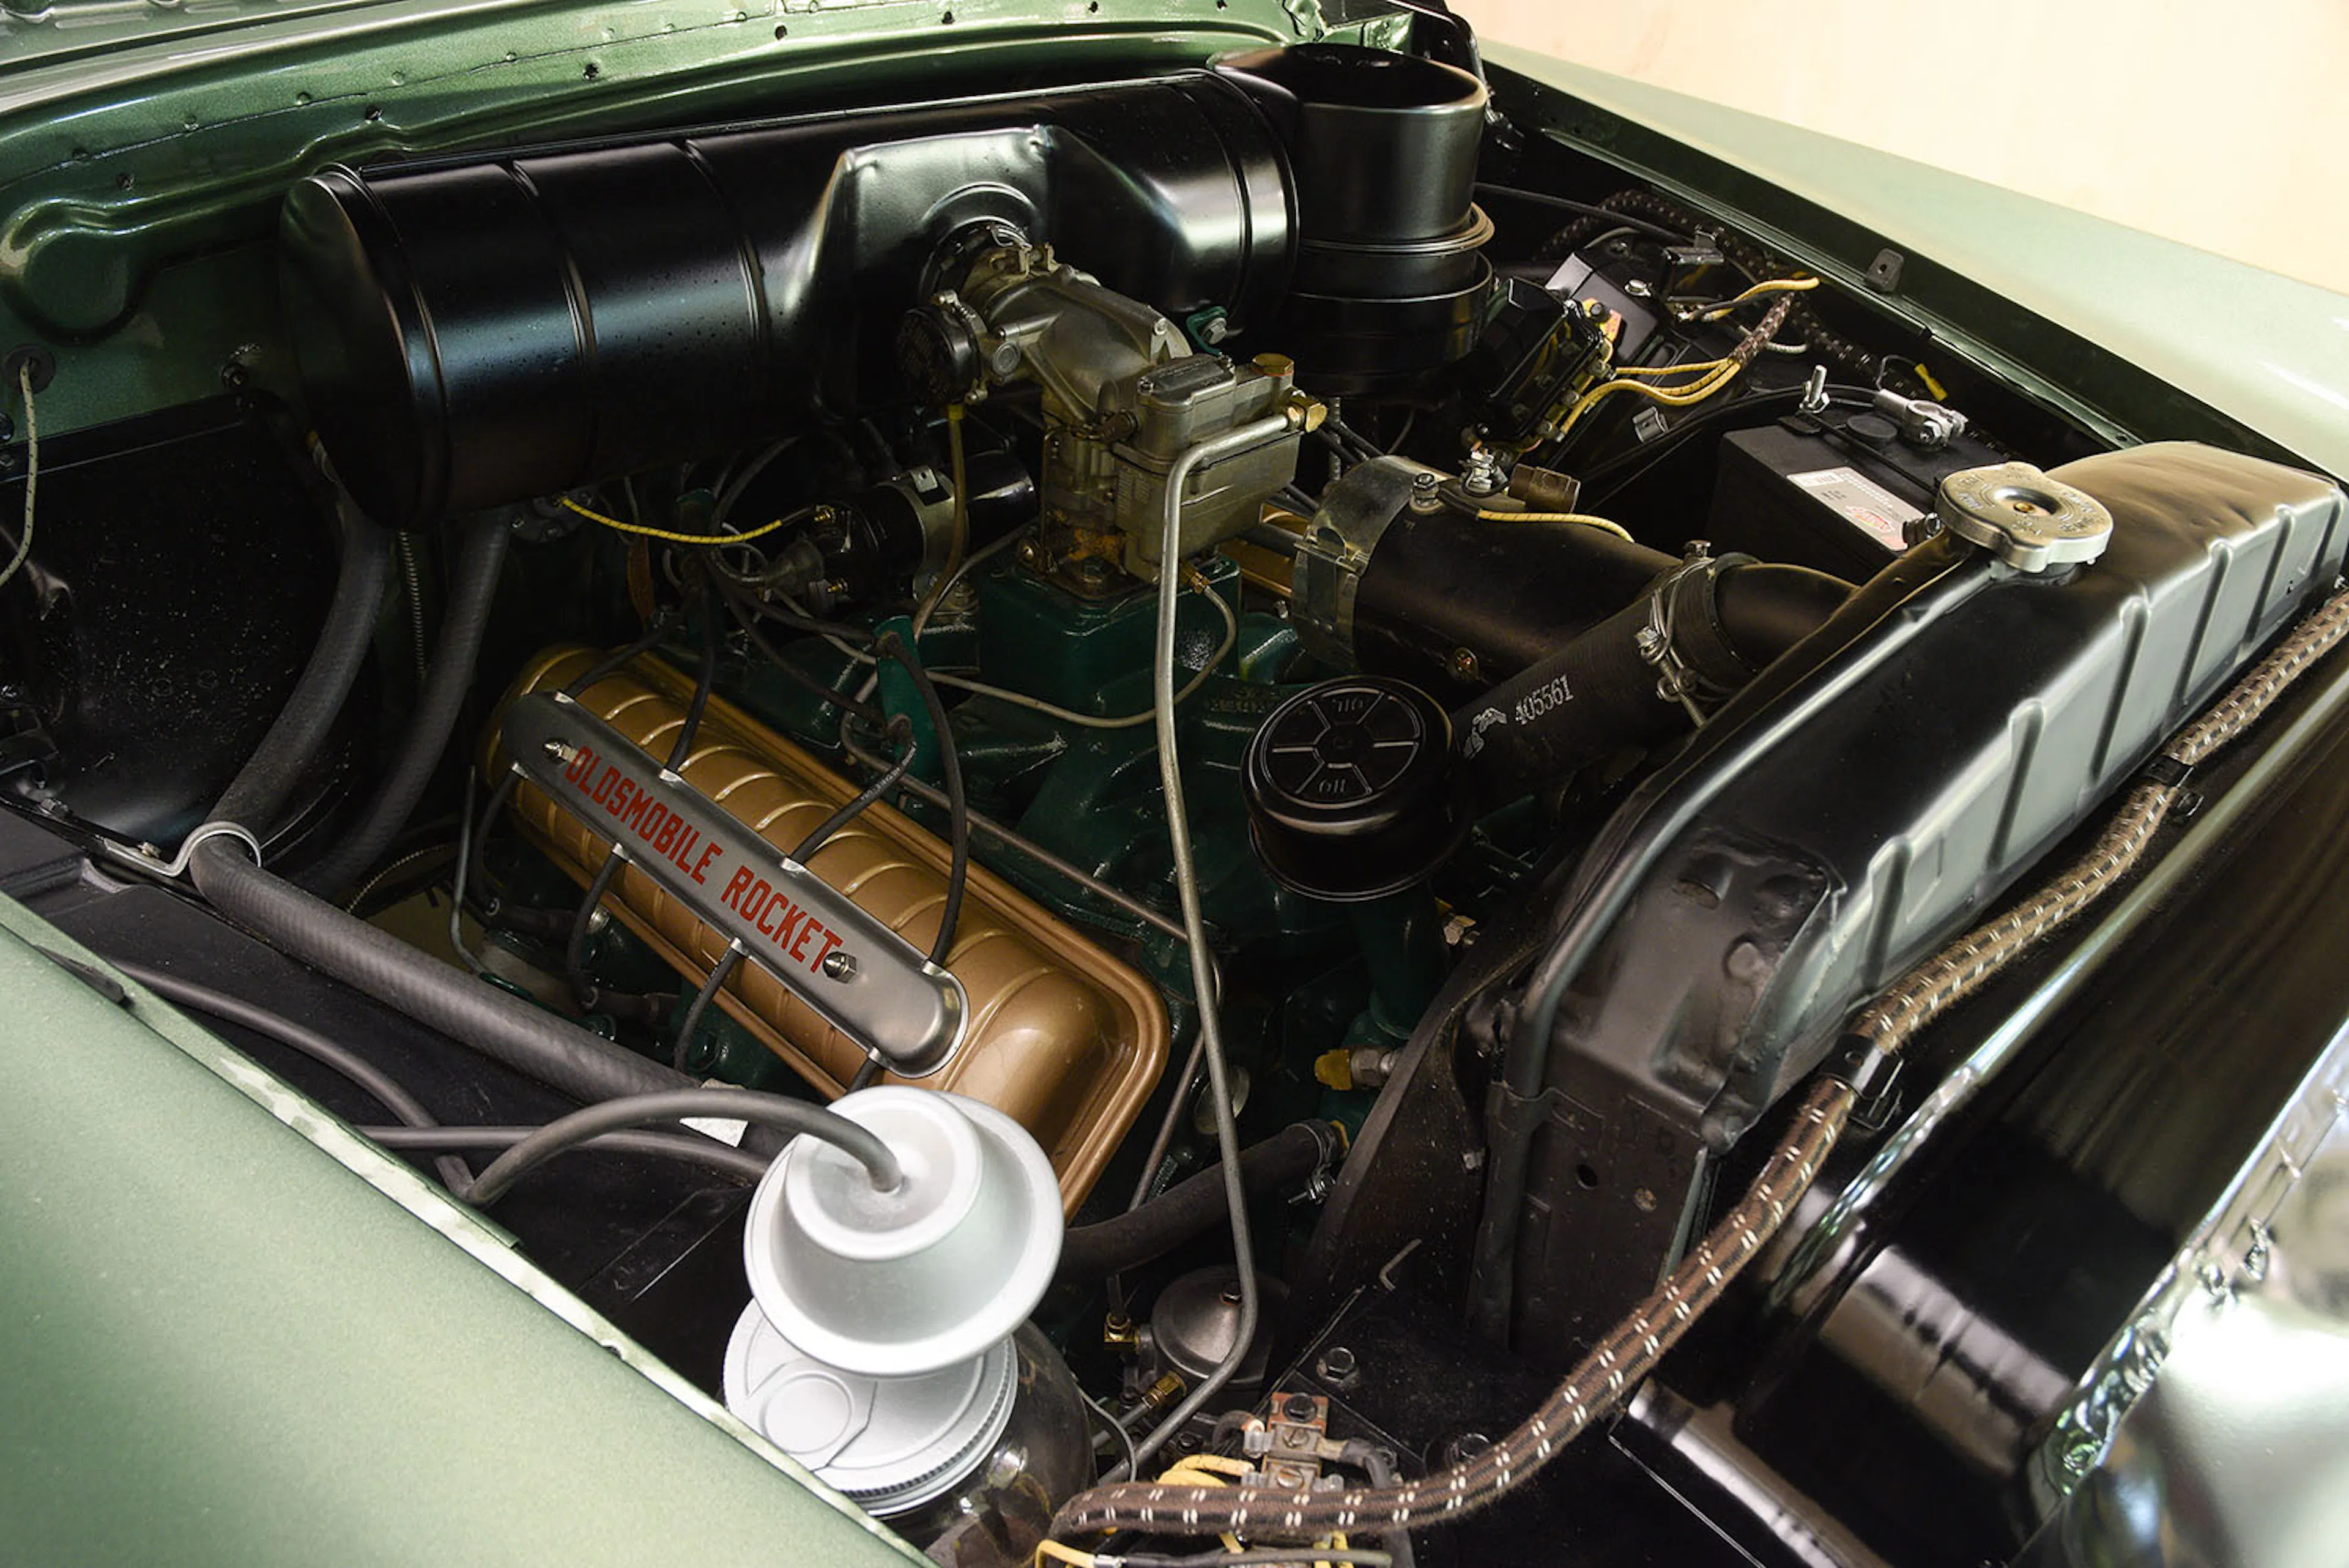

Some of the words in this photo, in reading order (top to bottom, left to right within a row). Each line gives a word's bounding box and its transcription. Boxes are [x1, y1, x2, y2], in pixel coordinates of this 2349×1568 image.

[1514, 674, 1575, 725] 405561
[565, 746, 723, 885] OLDSMOBILE
[721, 864, 844, 974] ROCKET
